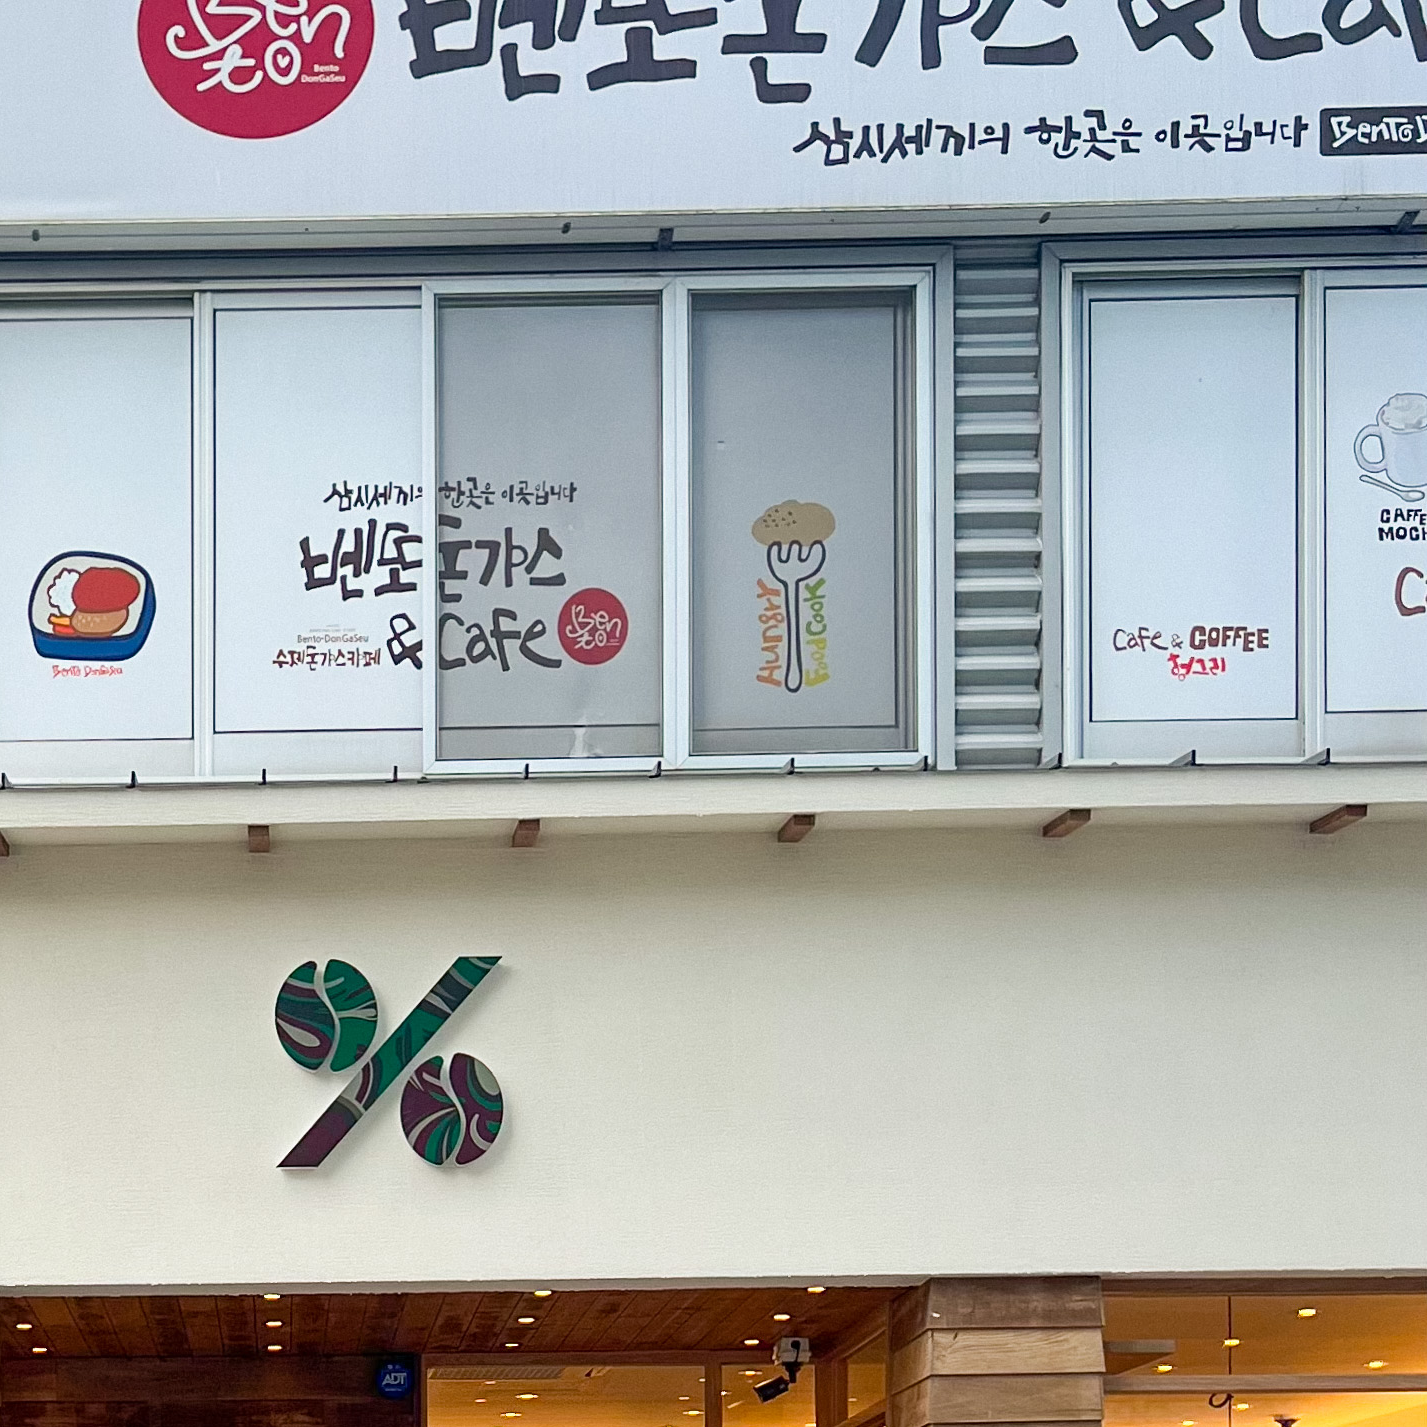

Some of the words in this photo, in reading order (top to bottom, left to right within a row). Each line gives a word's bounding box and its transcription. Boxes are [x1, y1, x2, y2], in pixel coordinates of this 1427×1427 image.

[1023, 109, 1142, 160] 한곳은
[1155, 113, 1309, 153] 이곳입니다
[439, 477, 495, 509] 한곳은
[502, 480, 577, 505] 이곳입니다
[1113, 626, 1168, 651] Cafe
[1171, 634, 1184, 650] &
[1189, 626, 1269, 652] COFFEE
[381, 1372, 407, 1386] ADT
